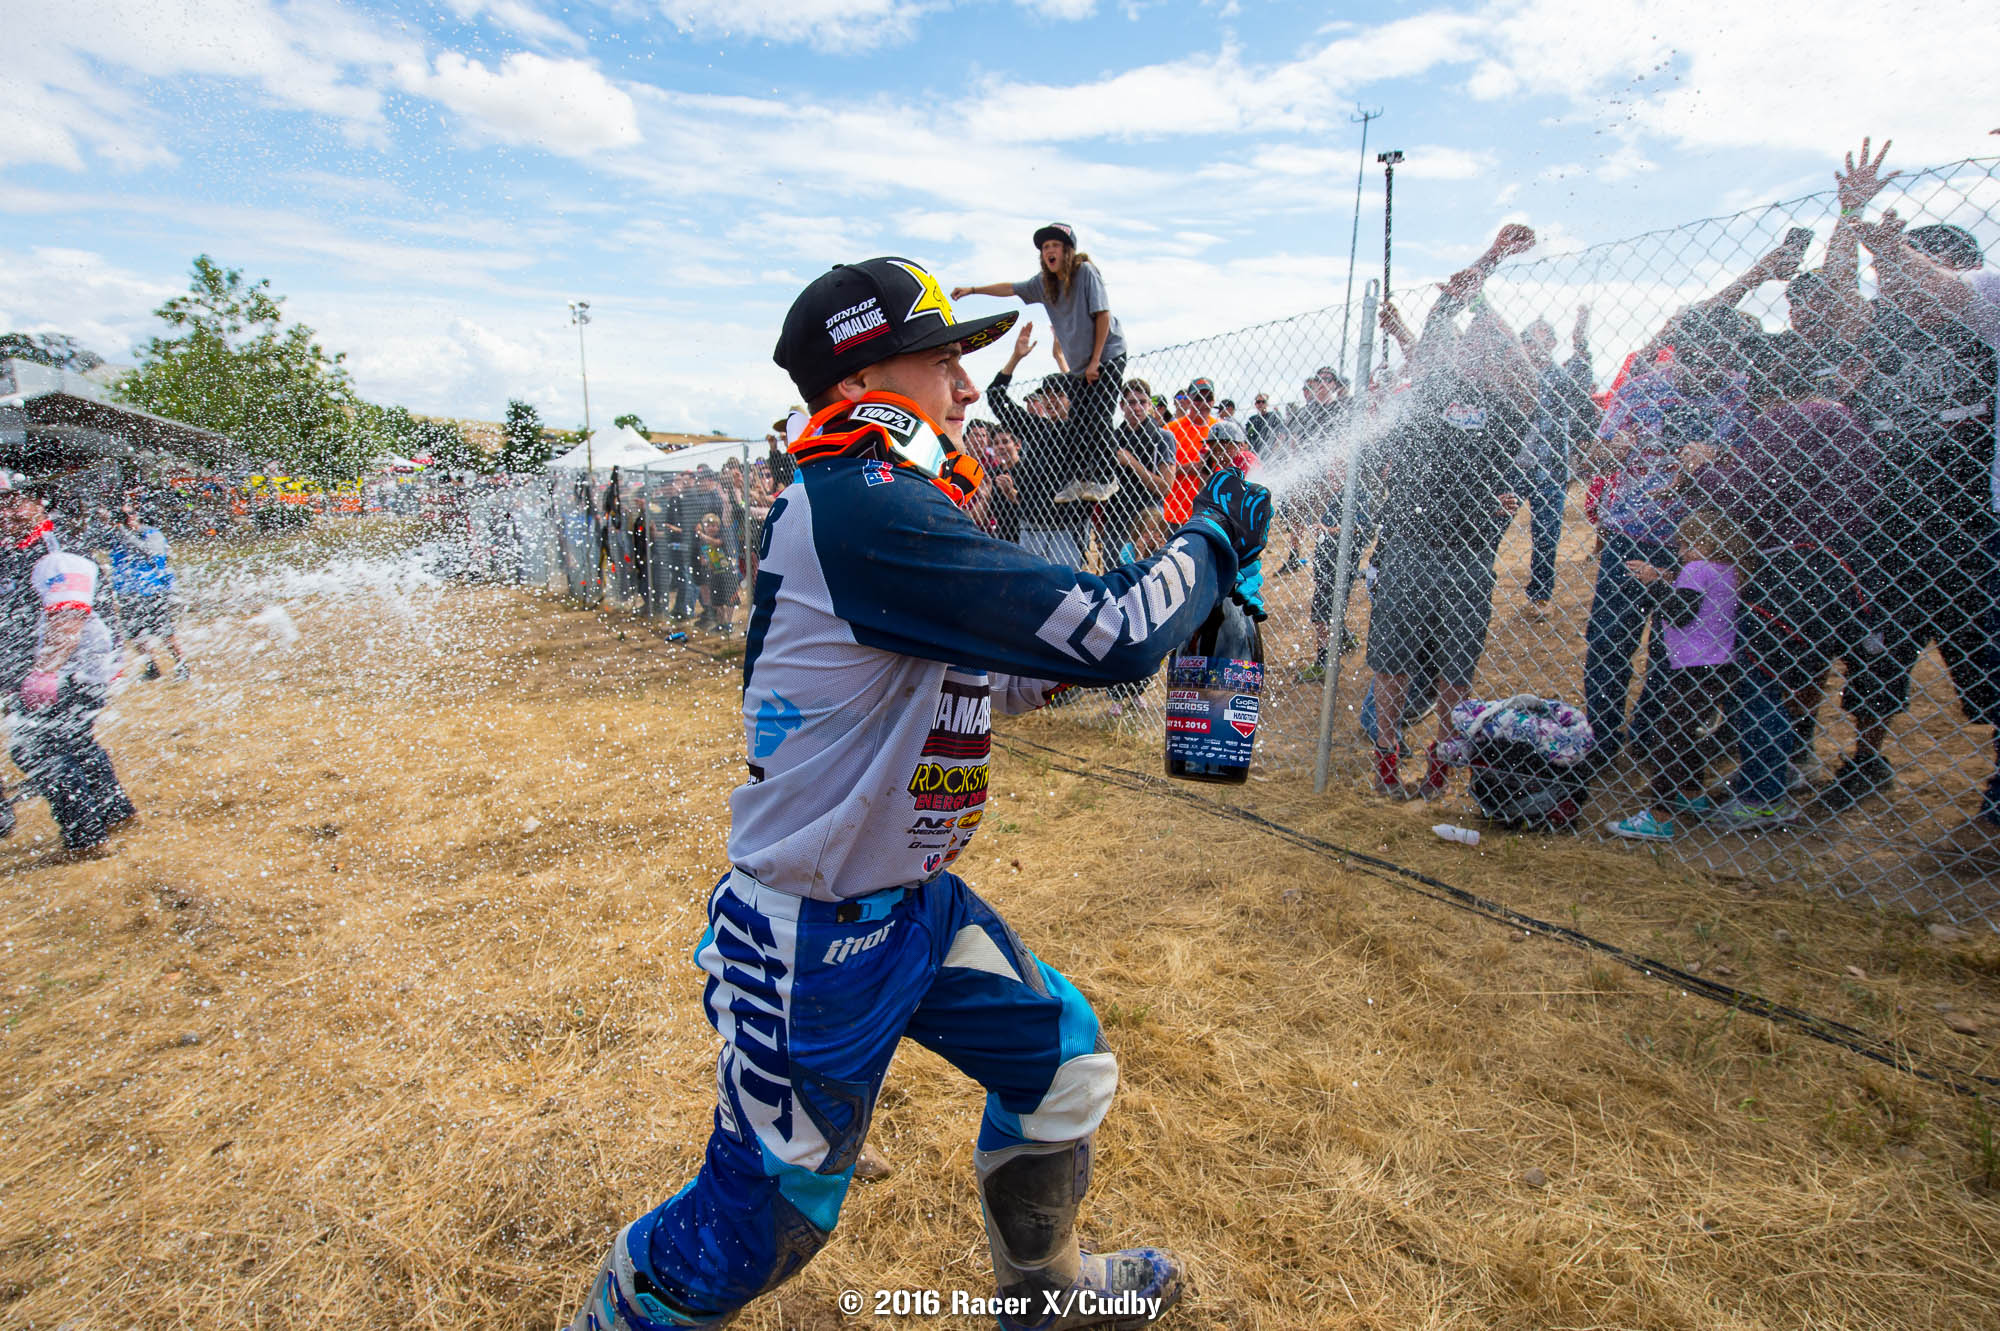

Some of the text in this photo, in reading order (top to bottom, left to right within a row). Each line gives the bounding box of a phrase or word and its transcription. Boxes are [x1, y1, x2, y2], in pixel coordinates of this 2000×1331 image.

[825, 297, 877, 329] DUNLOP
[828, 307, 887, 345] YAMALUBE
[861, 407, 906, 430] 100%
[1170, 691, 1198, 699] LUCAS OIL
[1174, 719, 1184, 728] 21,
[1185, 720, 1208, 730] 2016
[915, 793, 967, 809] ENERGY
